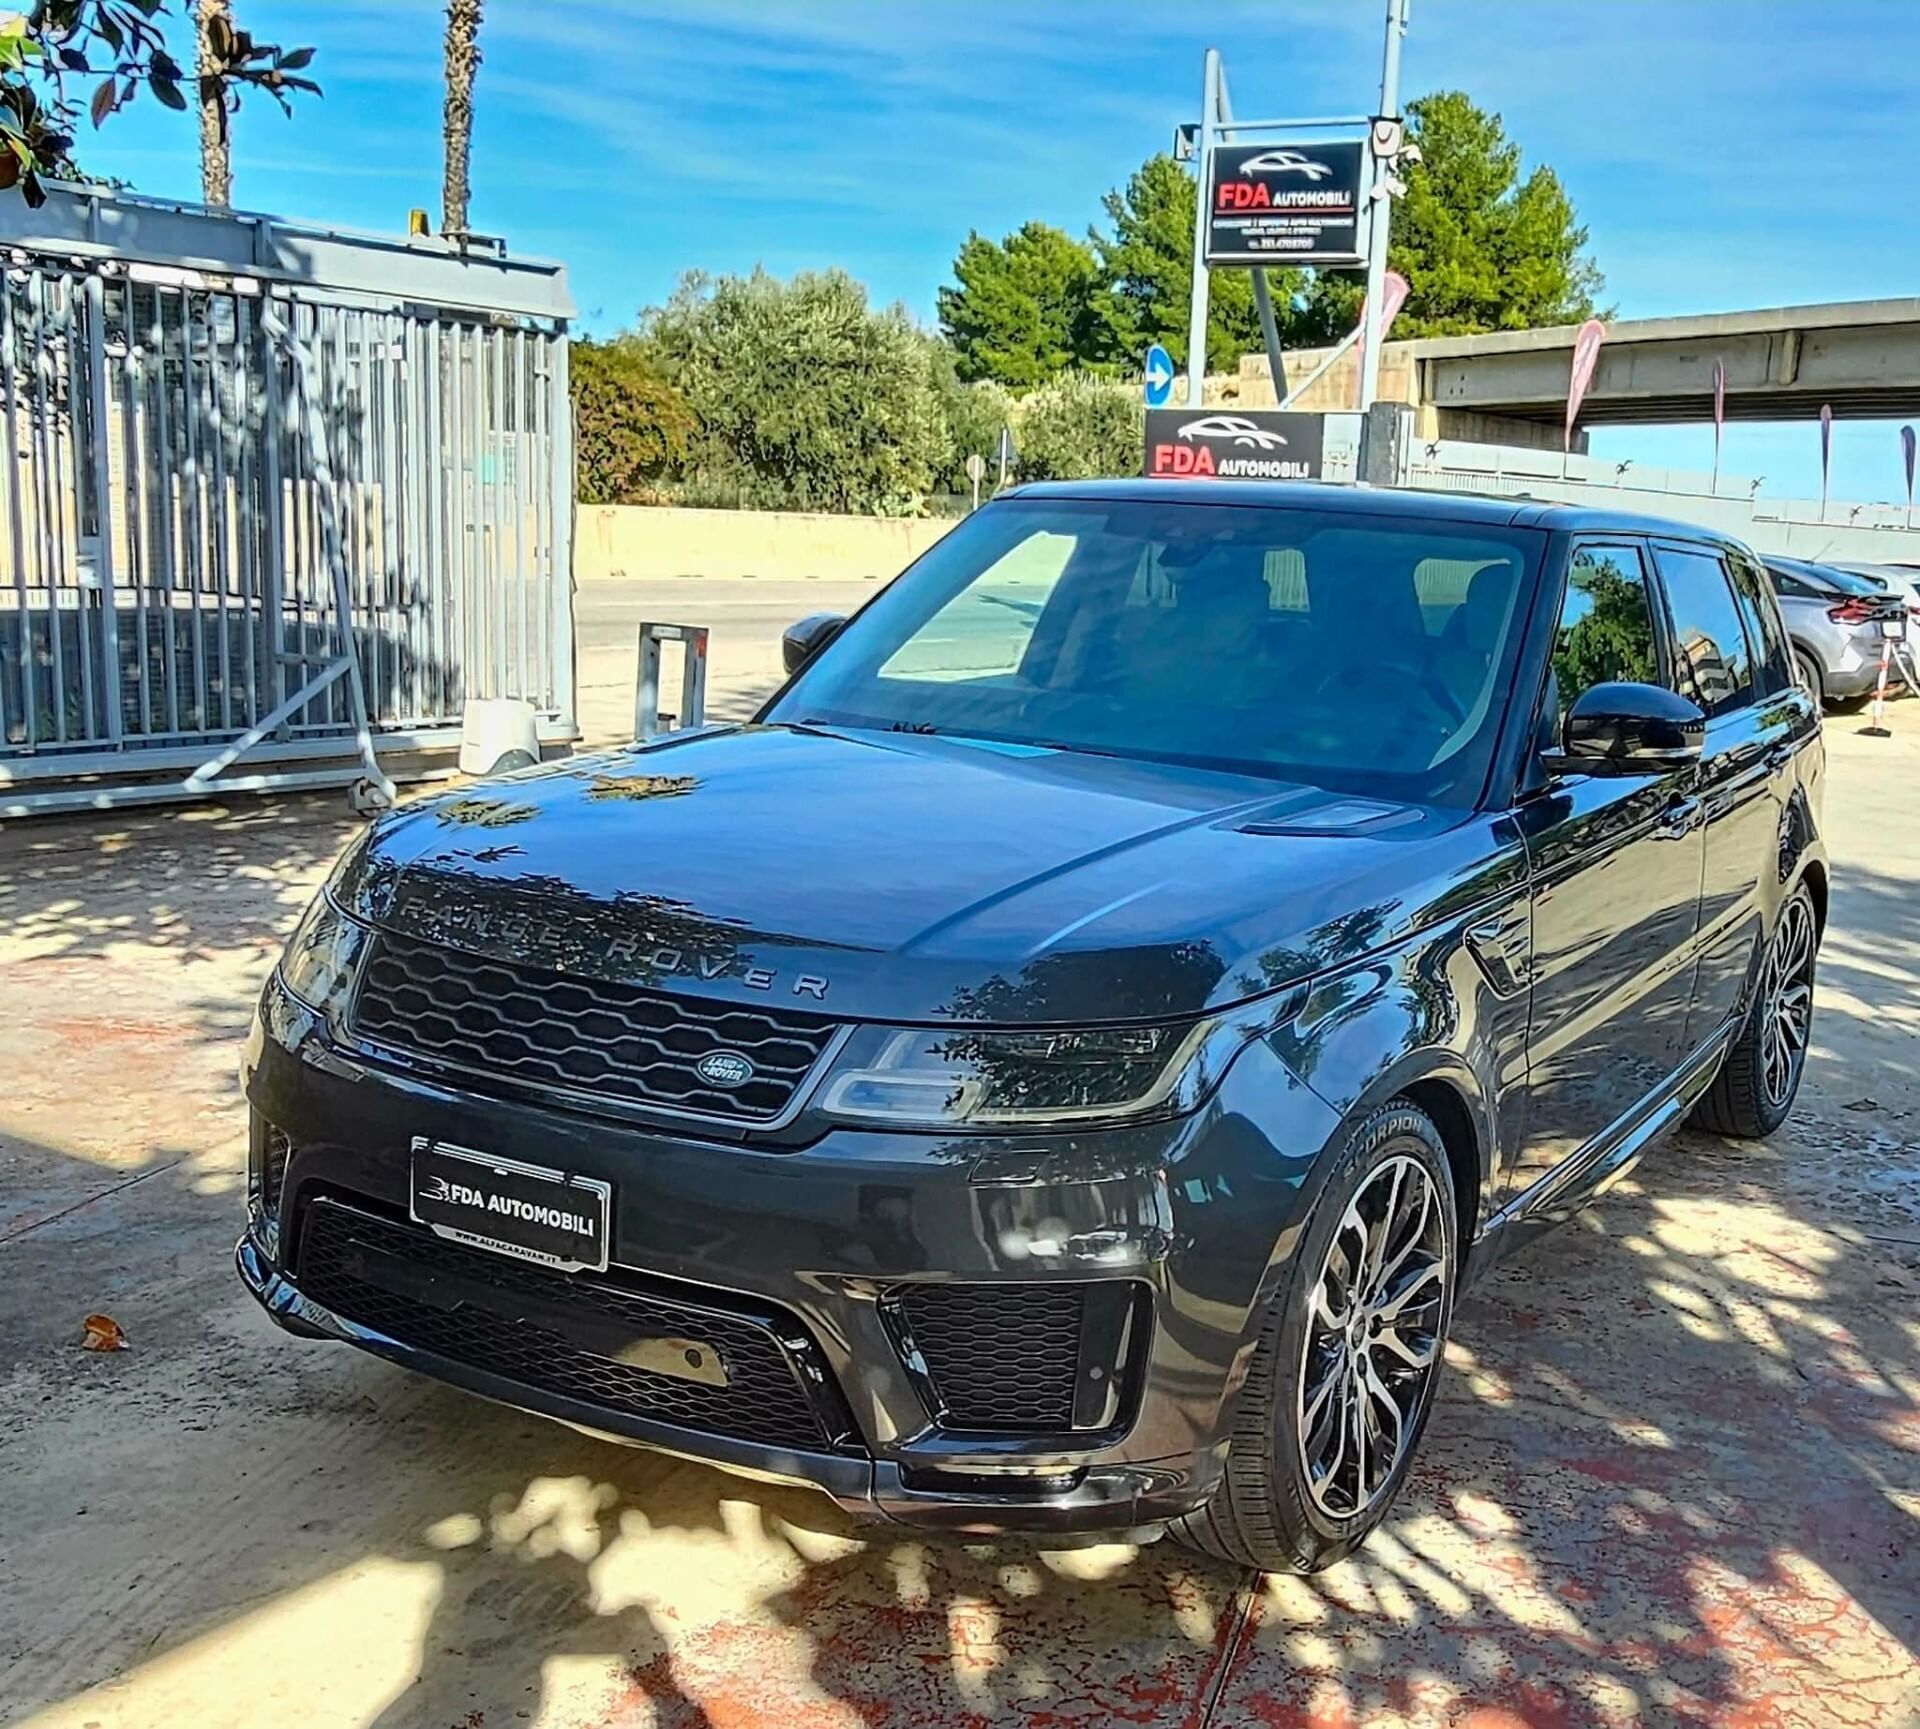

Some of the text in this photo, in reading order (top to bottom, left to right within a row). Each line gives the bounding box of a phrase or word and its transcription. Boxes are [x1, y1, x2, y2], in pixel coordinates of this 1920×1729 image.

[1218, 182, 1351, 208] FDA AUTOMOBILI
[1155, 444, 1310, 479] FDA AUTOMOBILI
[401, 897, 829, 999] RANGE ROVER
[707, 1057, 737, 1069] LAND
[707, 1066, 743, 1080] ROVER
[451, 1184, 595, 1237] FDA AUTOMOBILI
[454, 1231, 557, 1264] WWW.ALFACARAVAN.IT
